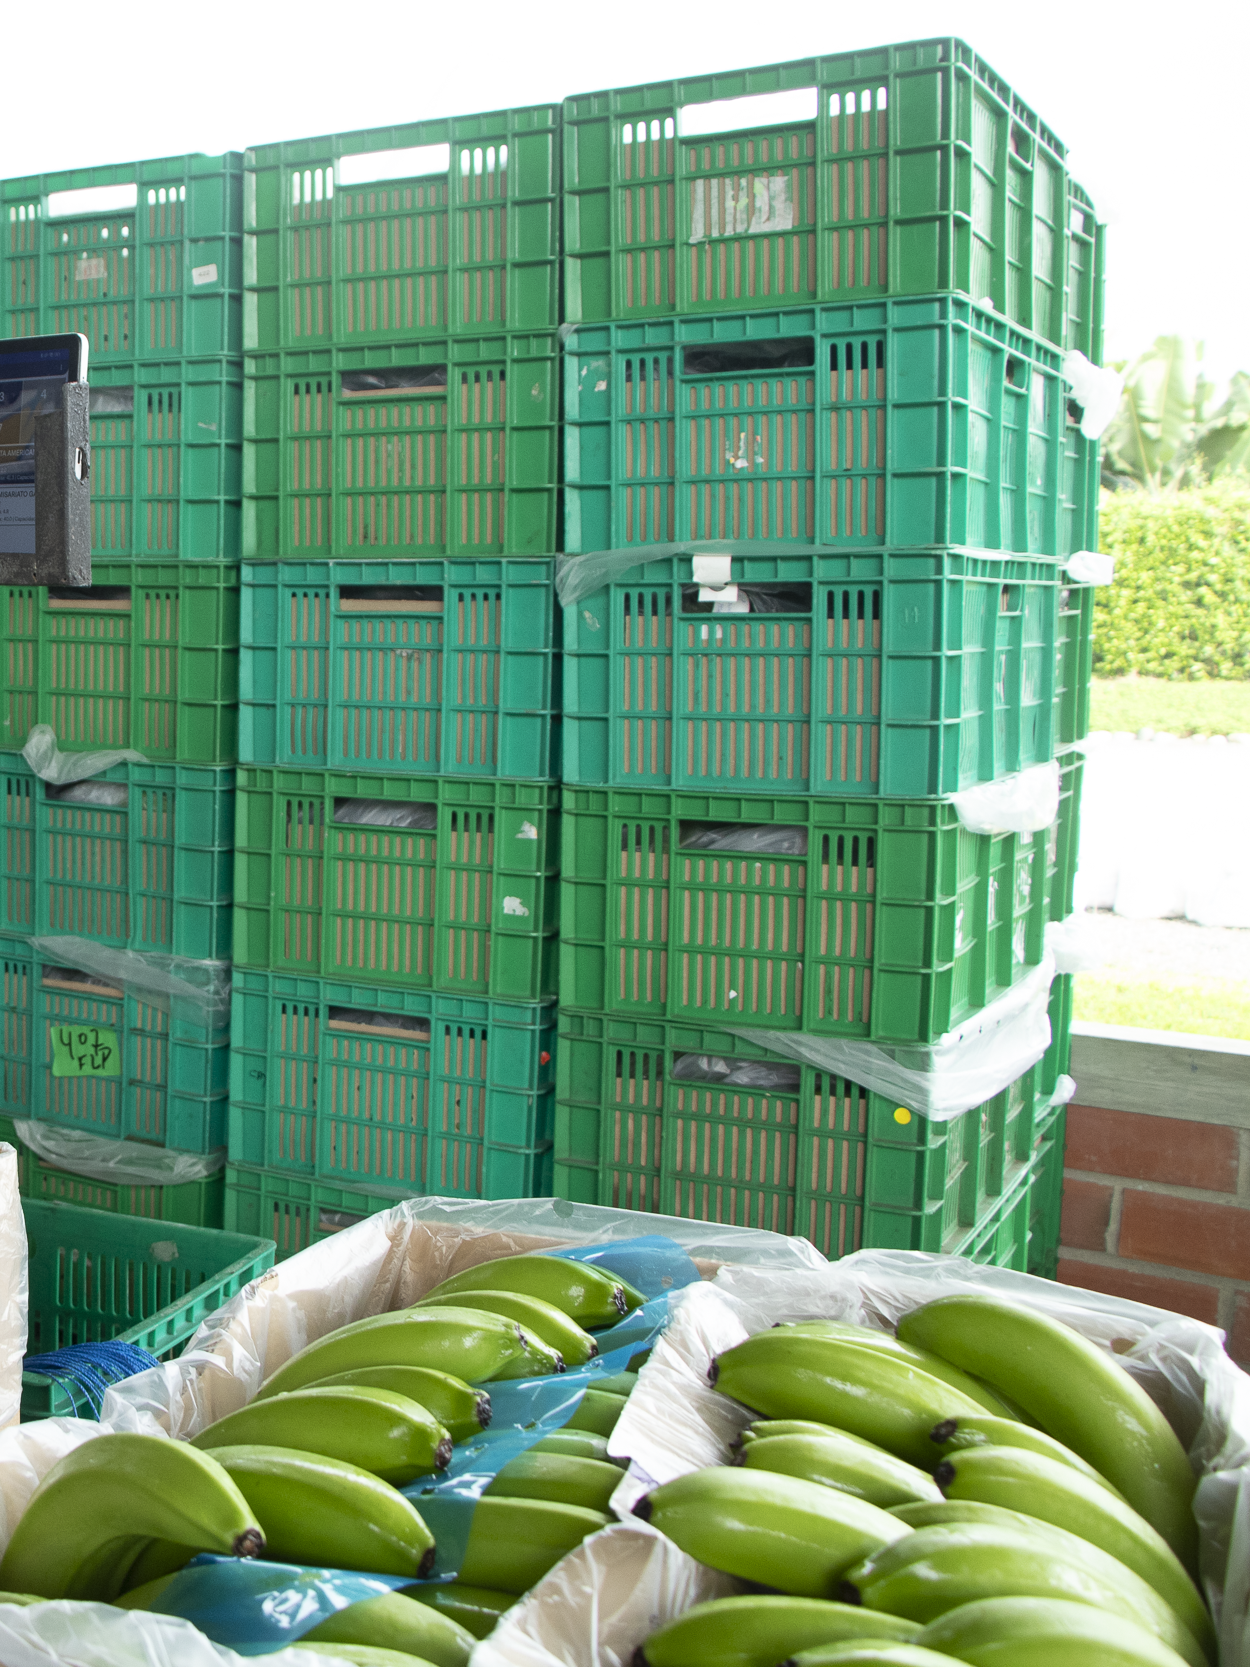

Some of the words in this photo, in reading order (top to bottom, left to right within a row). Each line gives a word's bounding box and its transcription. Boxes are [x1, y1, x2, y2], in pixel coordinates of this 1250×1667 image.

[40, 389, 47, 399] 4
[59, 1028, 104, 1060] 407
[78, 1046, 112, 1070] FLP
